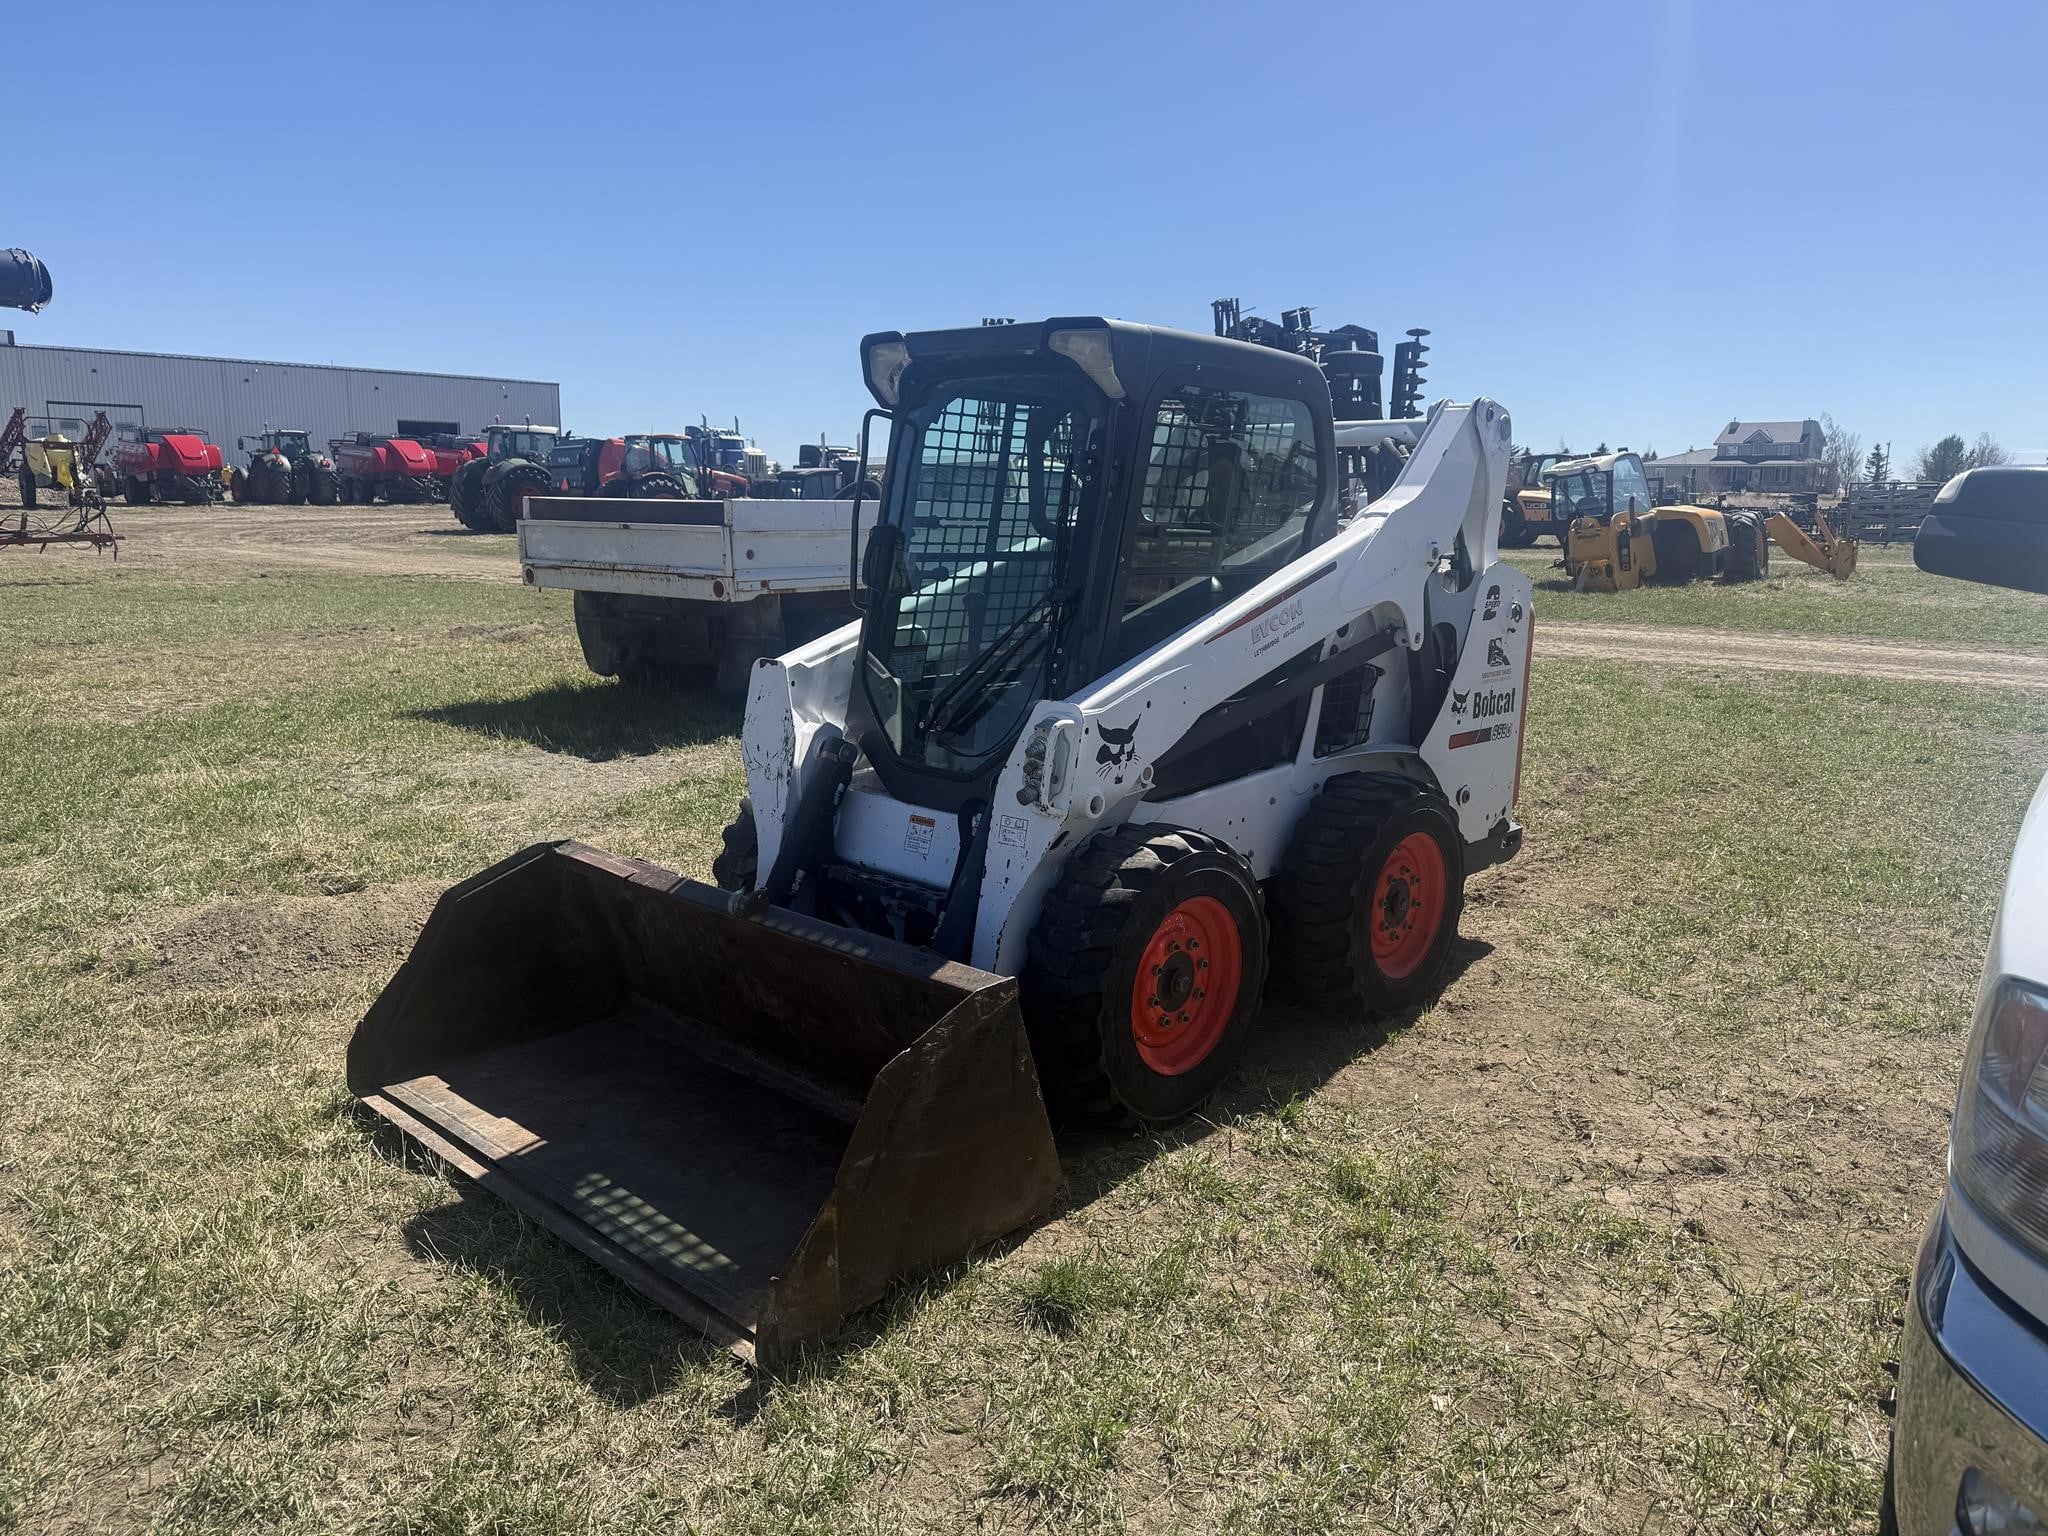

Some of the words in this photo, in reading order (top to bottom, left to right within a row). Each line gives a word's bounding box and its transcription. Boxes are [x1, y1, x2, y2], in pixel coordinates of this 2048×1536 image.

[1484, 600, 1501, 609] SPEED
[1251, 599, 1303, 645] EVCON
[1472, 688, 1516, 719] Bobcat
